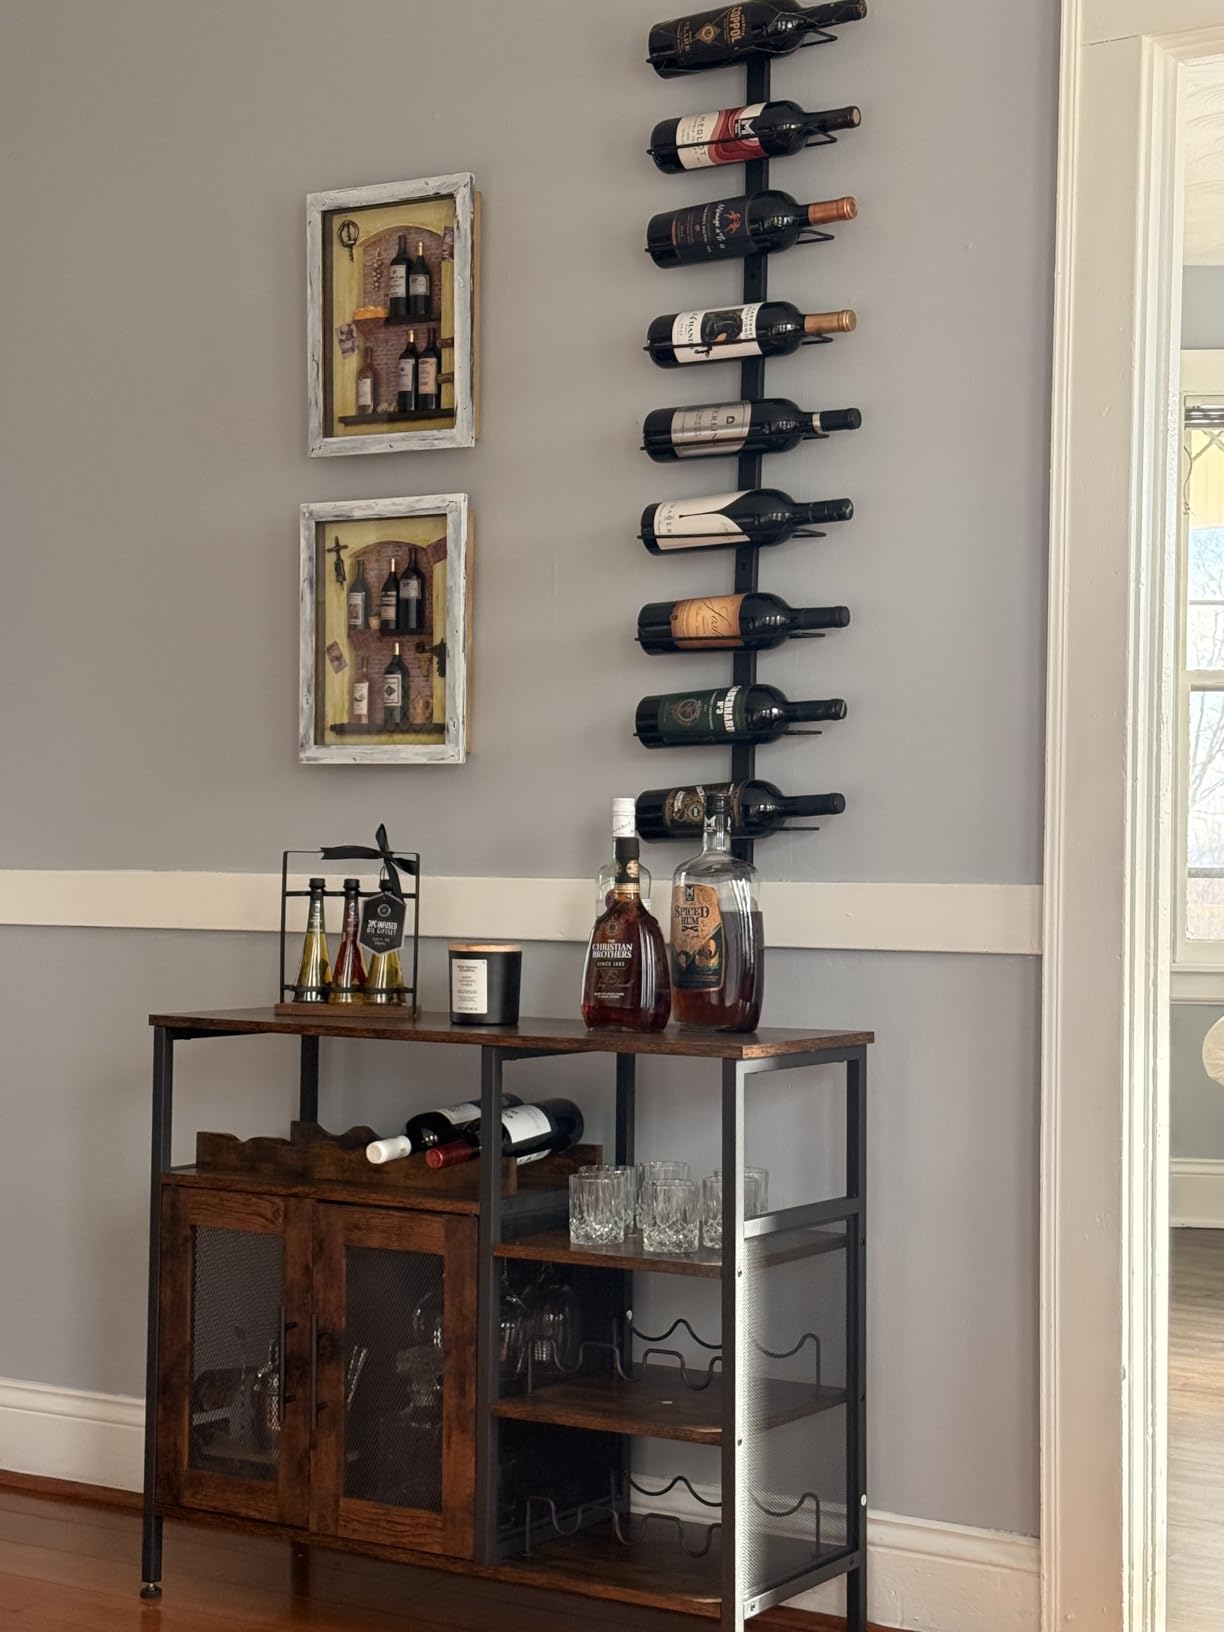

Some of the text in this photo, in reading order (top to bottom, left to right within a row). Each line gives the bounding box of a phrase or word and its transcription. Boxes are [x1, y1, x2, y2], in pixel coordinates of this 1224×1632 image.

[730, 6, 743, 44] COPPOL
[675, 905, 710, 918] SPICED
[378, 920, 398, 930] INFUSED
[681, 916, 699, 925] RUM
[592, 943, 633, 951] CHRISTIAN
[592, 950, 632, 958] BROTHERS
